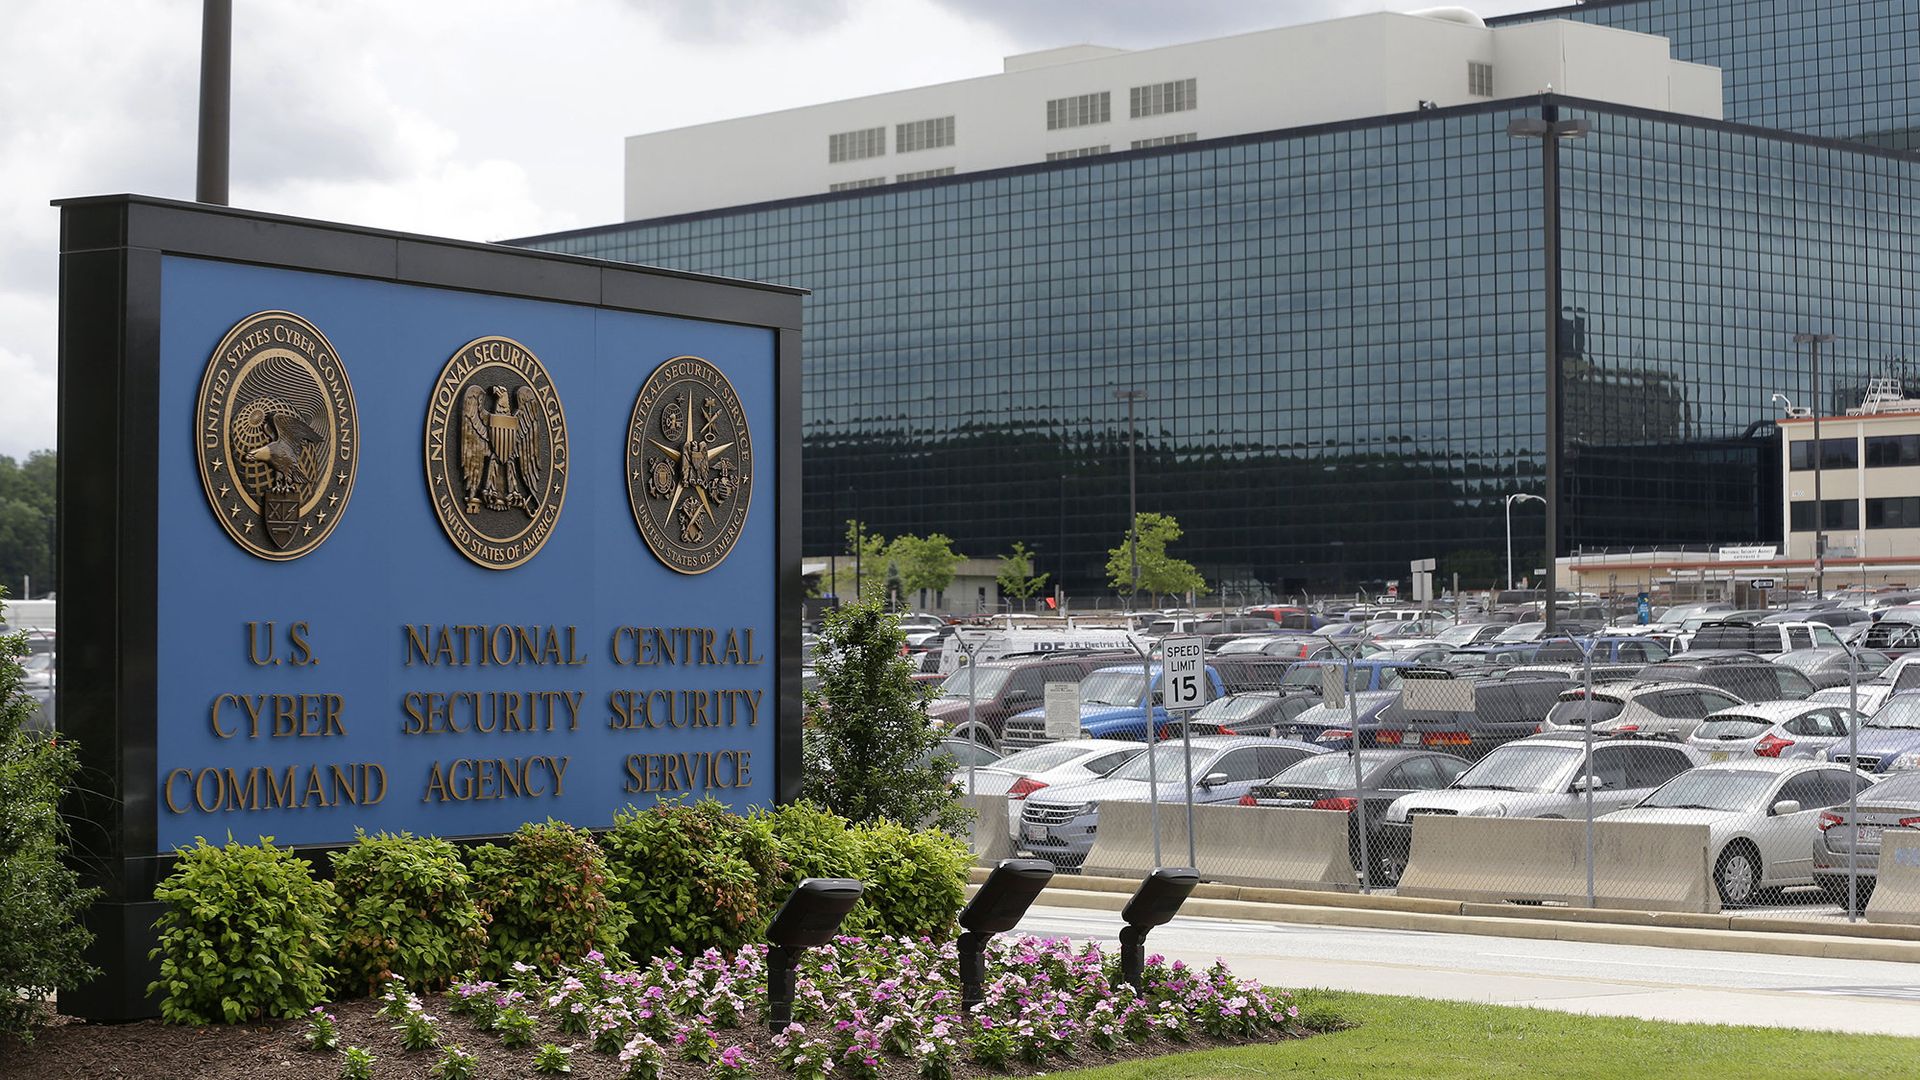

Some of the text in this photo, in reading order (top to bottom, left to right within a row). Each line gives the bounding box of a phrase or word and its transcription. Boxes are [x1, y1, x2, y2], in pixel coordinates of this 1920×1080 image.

[206, 324, 351, 461] UNITED STATES CYBER COMMAND
[431, 342, 566, 475] NATIONAL SECURITY AGENCY
[631, 362, 750, 462] CENTRAL SECURITY SERVICE
[440, 494, 557, 562] UNITED STATES OF AMERICA
[638, 503, 744, 567] UNITED STATES OF AMERICA
[247, 620, 321, 666] U.S.
[404, 623, 588, 666] NATIONAL
[612, 625, 765, 666] CENTRAL
[1167, 645, 1200, 658] SPEED
[1171, 660, 1196, 672] LIMIT
[608, 687, 764, 729] SECURITY
[1172, 675, 1197, 702] 15
[211, 692, 348, 739] CYBER
[403, 690, 586, 735] SECURITY
[165, 762, 388, 814] COMMAND
[423, 755, 571, 802] AGENCY
[623, 749, 753, 793] SERVICE
